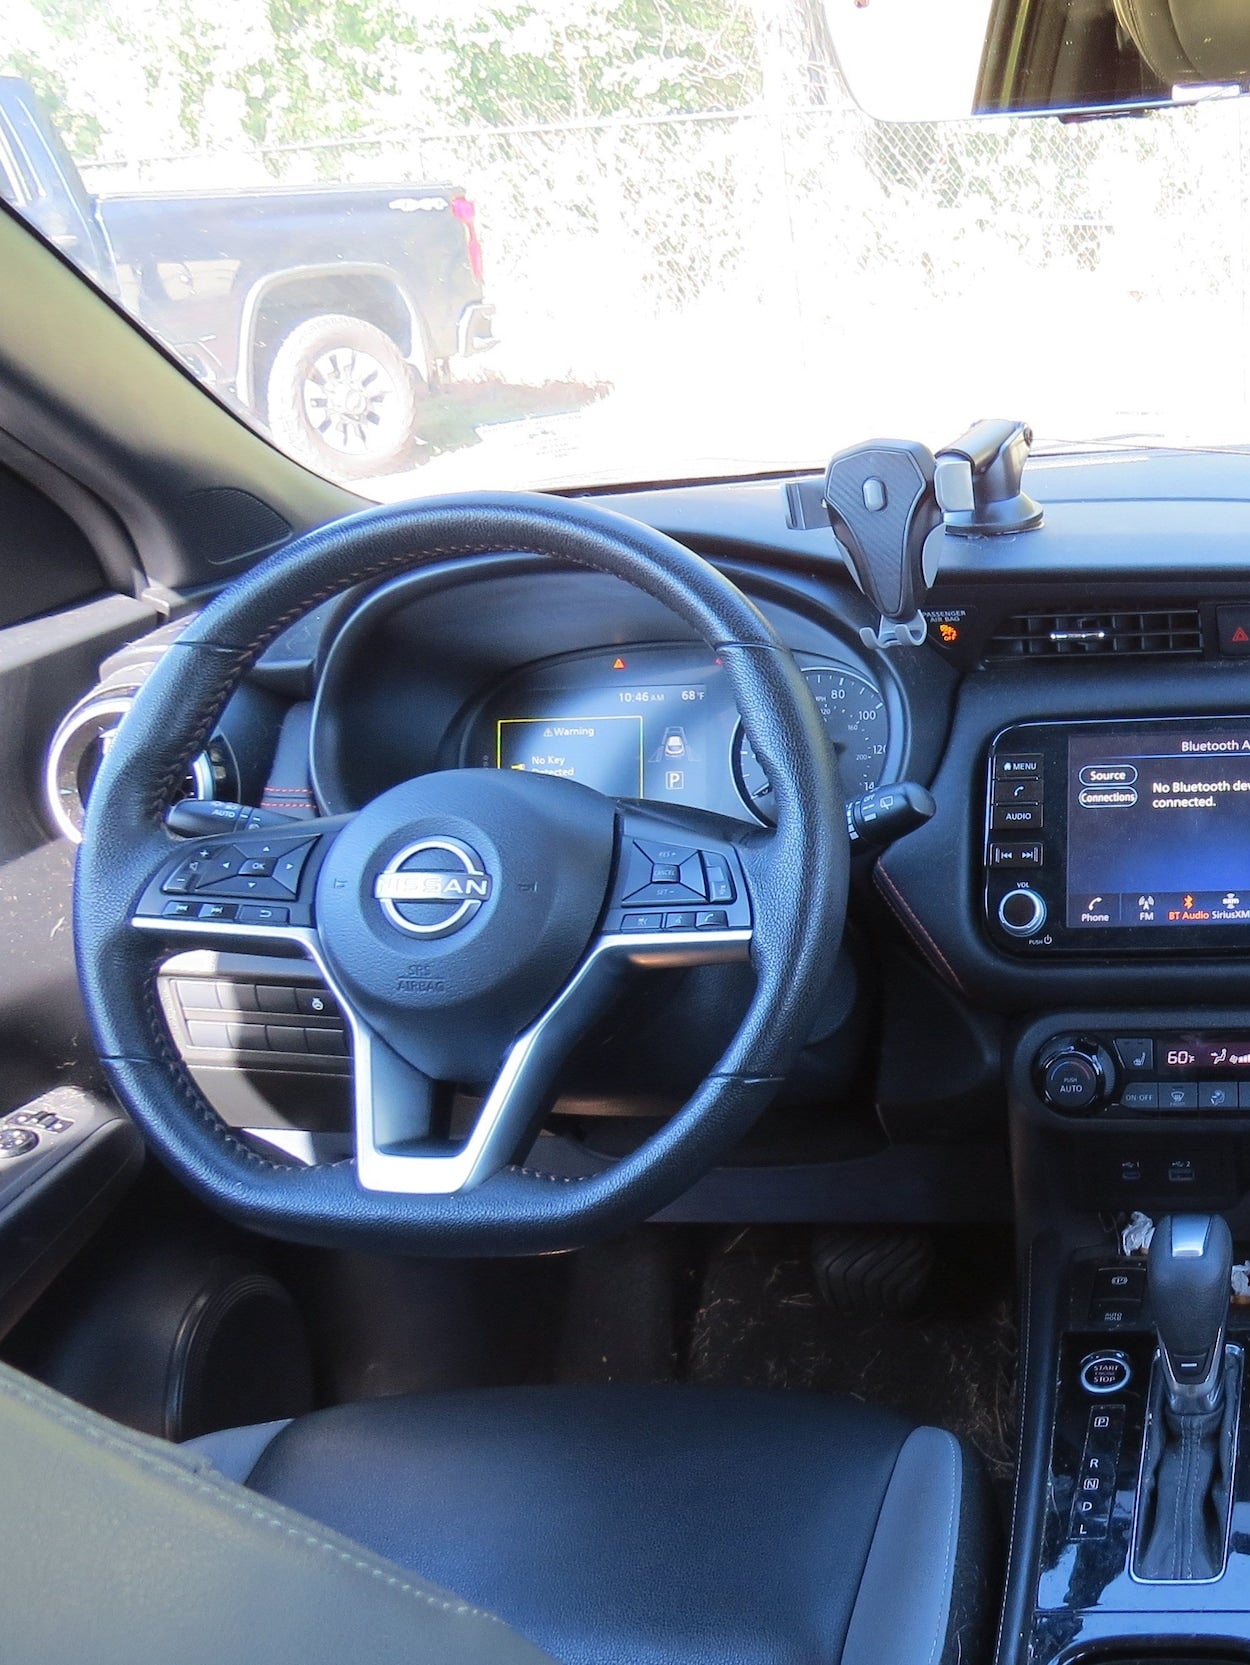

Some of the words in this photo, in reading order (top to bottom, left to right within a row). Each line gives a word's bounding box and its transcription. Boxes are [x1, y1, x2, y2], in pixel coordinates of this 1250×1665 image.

[619, 691, 649, 702] 10:46
[831, 689, 846, 700] 80
[858, 710, 877, 720] 100
[553, 727, 595, 737] Warning
[1181, 740, 1239, 752] Bluetooth
[531, 755, 546, 765] No
[547, 755, 566, 766] Key
[1012, 762, 1037, 771] MENU
[1089, 771, 1127, 781] Source
[1152, 782, 1171, 794] No
[1172, 780, 1231, 793] Bluetooth
[1081, 791, 1136, 803] Connections
[1152, 796, 1217, 809] connected.
[211, 809, 236, 818] AUTO
[1005, 812, 1032, 821] AUDIO
[252, 862, 265, 870] OK
[1081, 913, 1110, 922] Phone
[1139, 912, 1154, 921] FM
[1168, 911, 1180, 920] BT
[1181, 910, 1209, 920] Audio
[1211, 910, 1250, 920] SiriusXM
[1060, 1085, 1083, 1093] AUTO
[1089, 1458, 1099, 1469] R
[1082, 1501, 1093, 1511] D
[1079, 1523, 1087, 1535] L
